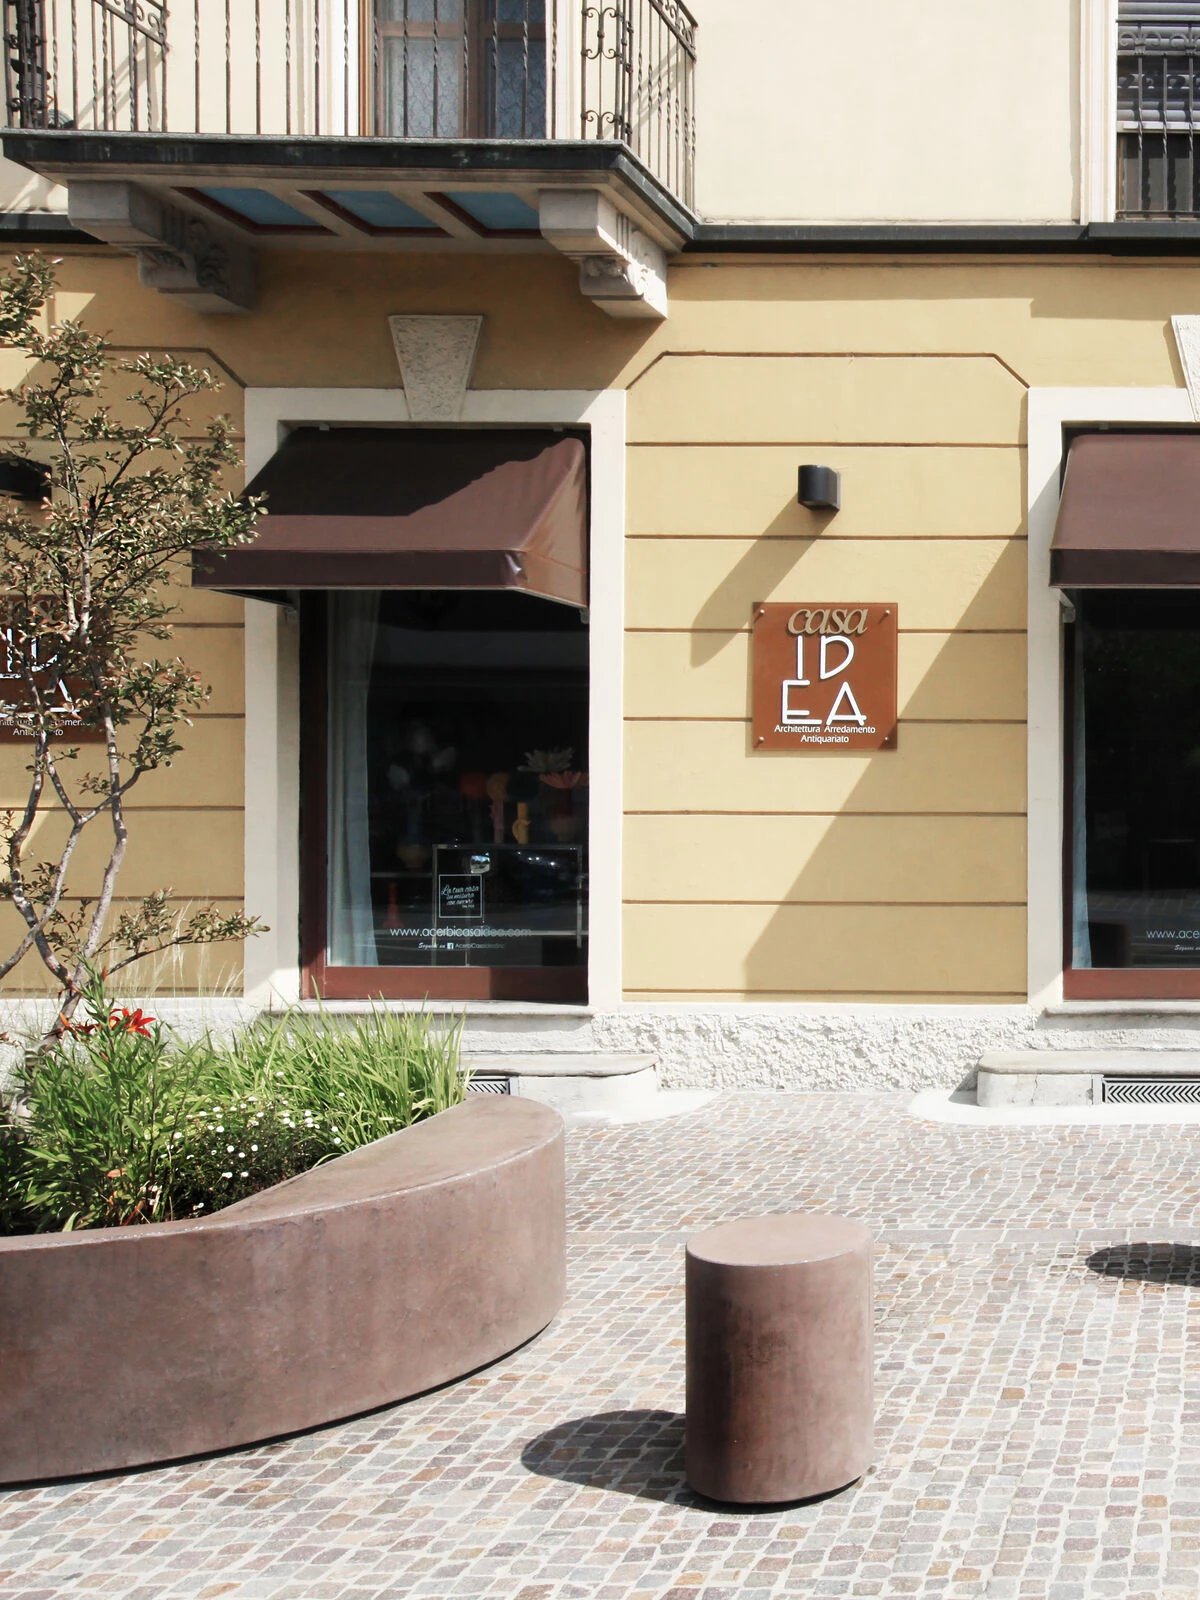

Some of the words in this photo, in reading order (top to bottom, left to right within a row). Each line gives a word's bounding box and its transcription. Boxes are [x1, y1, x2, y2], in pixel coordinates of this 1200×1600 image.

[787, 608, 869, 635] casa
[774, 725, 821, 733] Architettura
[824, 726, 876, 734] Arredamento
[800, 735, 850, 744] Antiquariato
